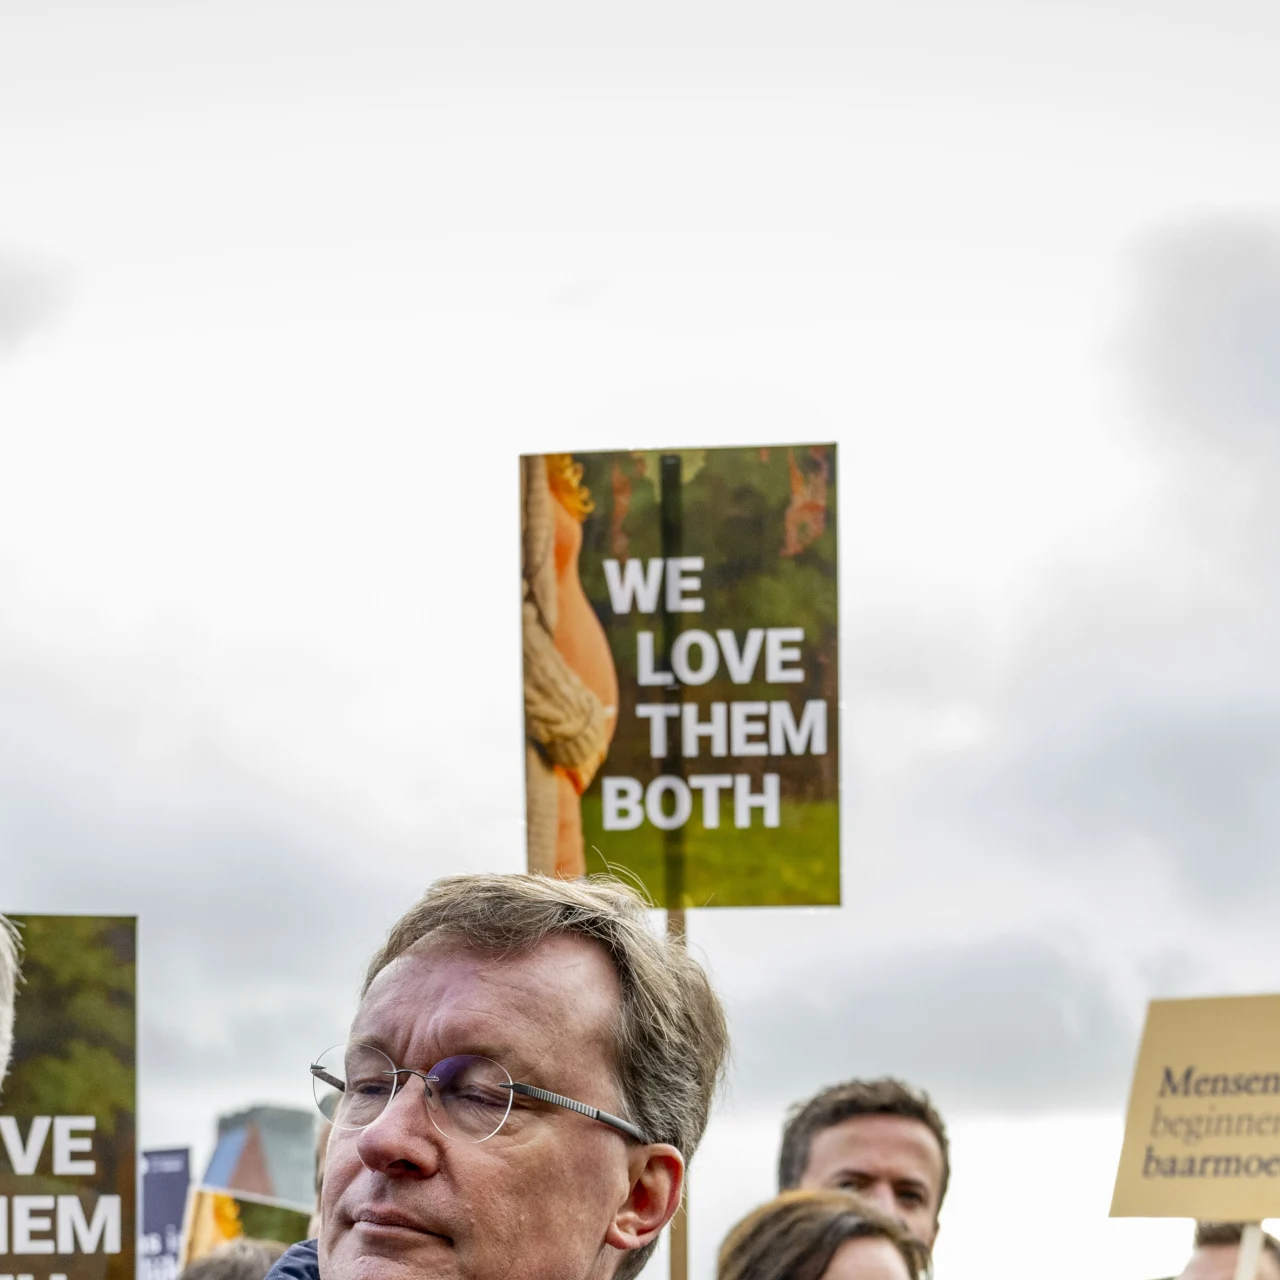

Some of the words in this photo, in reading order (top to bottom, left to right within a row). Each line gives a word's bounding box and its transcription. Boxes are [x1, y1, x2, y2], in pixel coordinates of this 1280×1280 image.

[602, 556, 705, 614] WE
[636, 628, 805, 687] LOVE
[636, 699, 828, 758] THEM
[601, 773, 781, 831] BOTH
